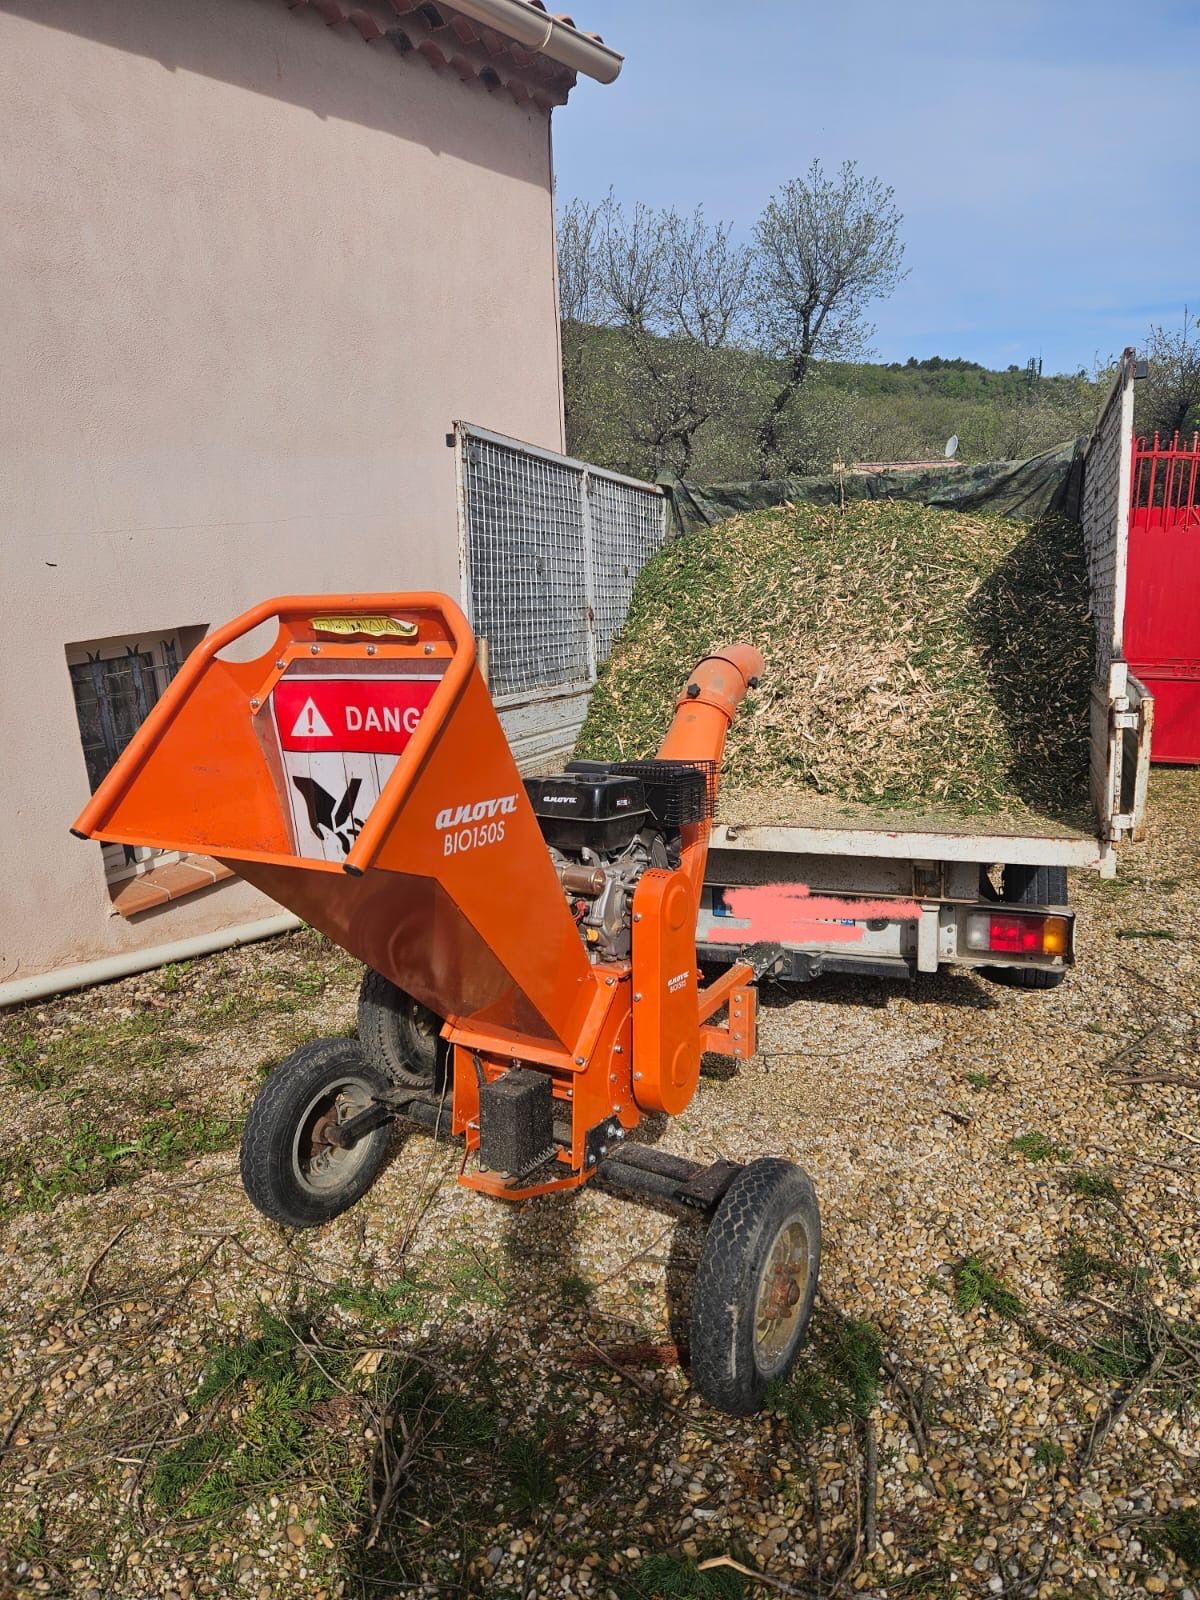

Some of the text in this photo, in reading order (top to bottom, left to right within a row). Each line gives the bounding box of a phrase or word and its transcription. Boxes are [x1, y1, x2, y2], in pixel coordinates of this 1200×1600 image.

[345, 705, 426, 734] DANG
[435, 794, 518, 830] anova
[444, 820, 505, 857] BIO150S
